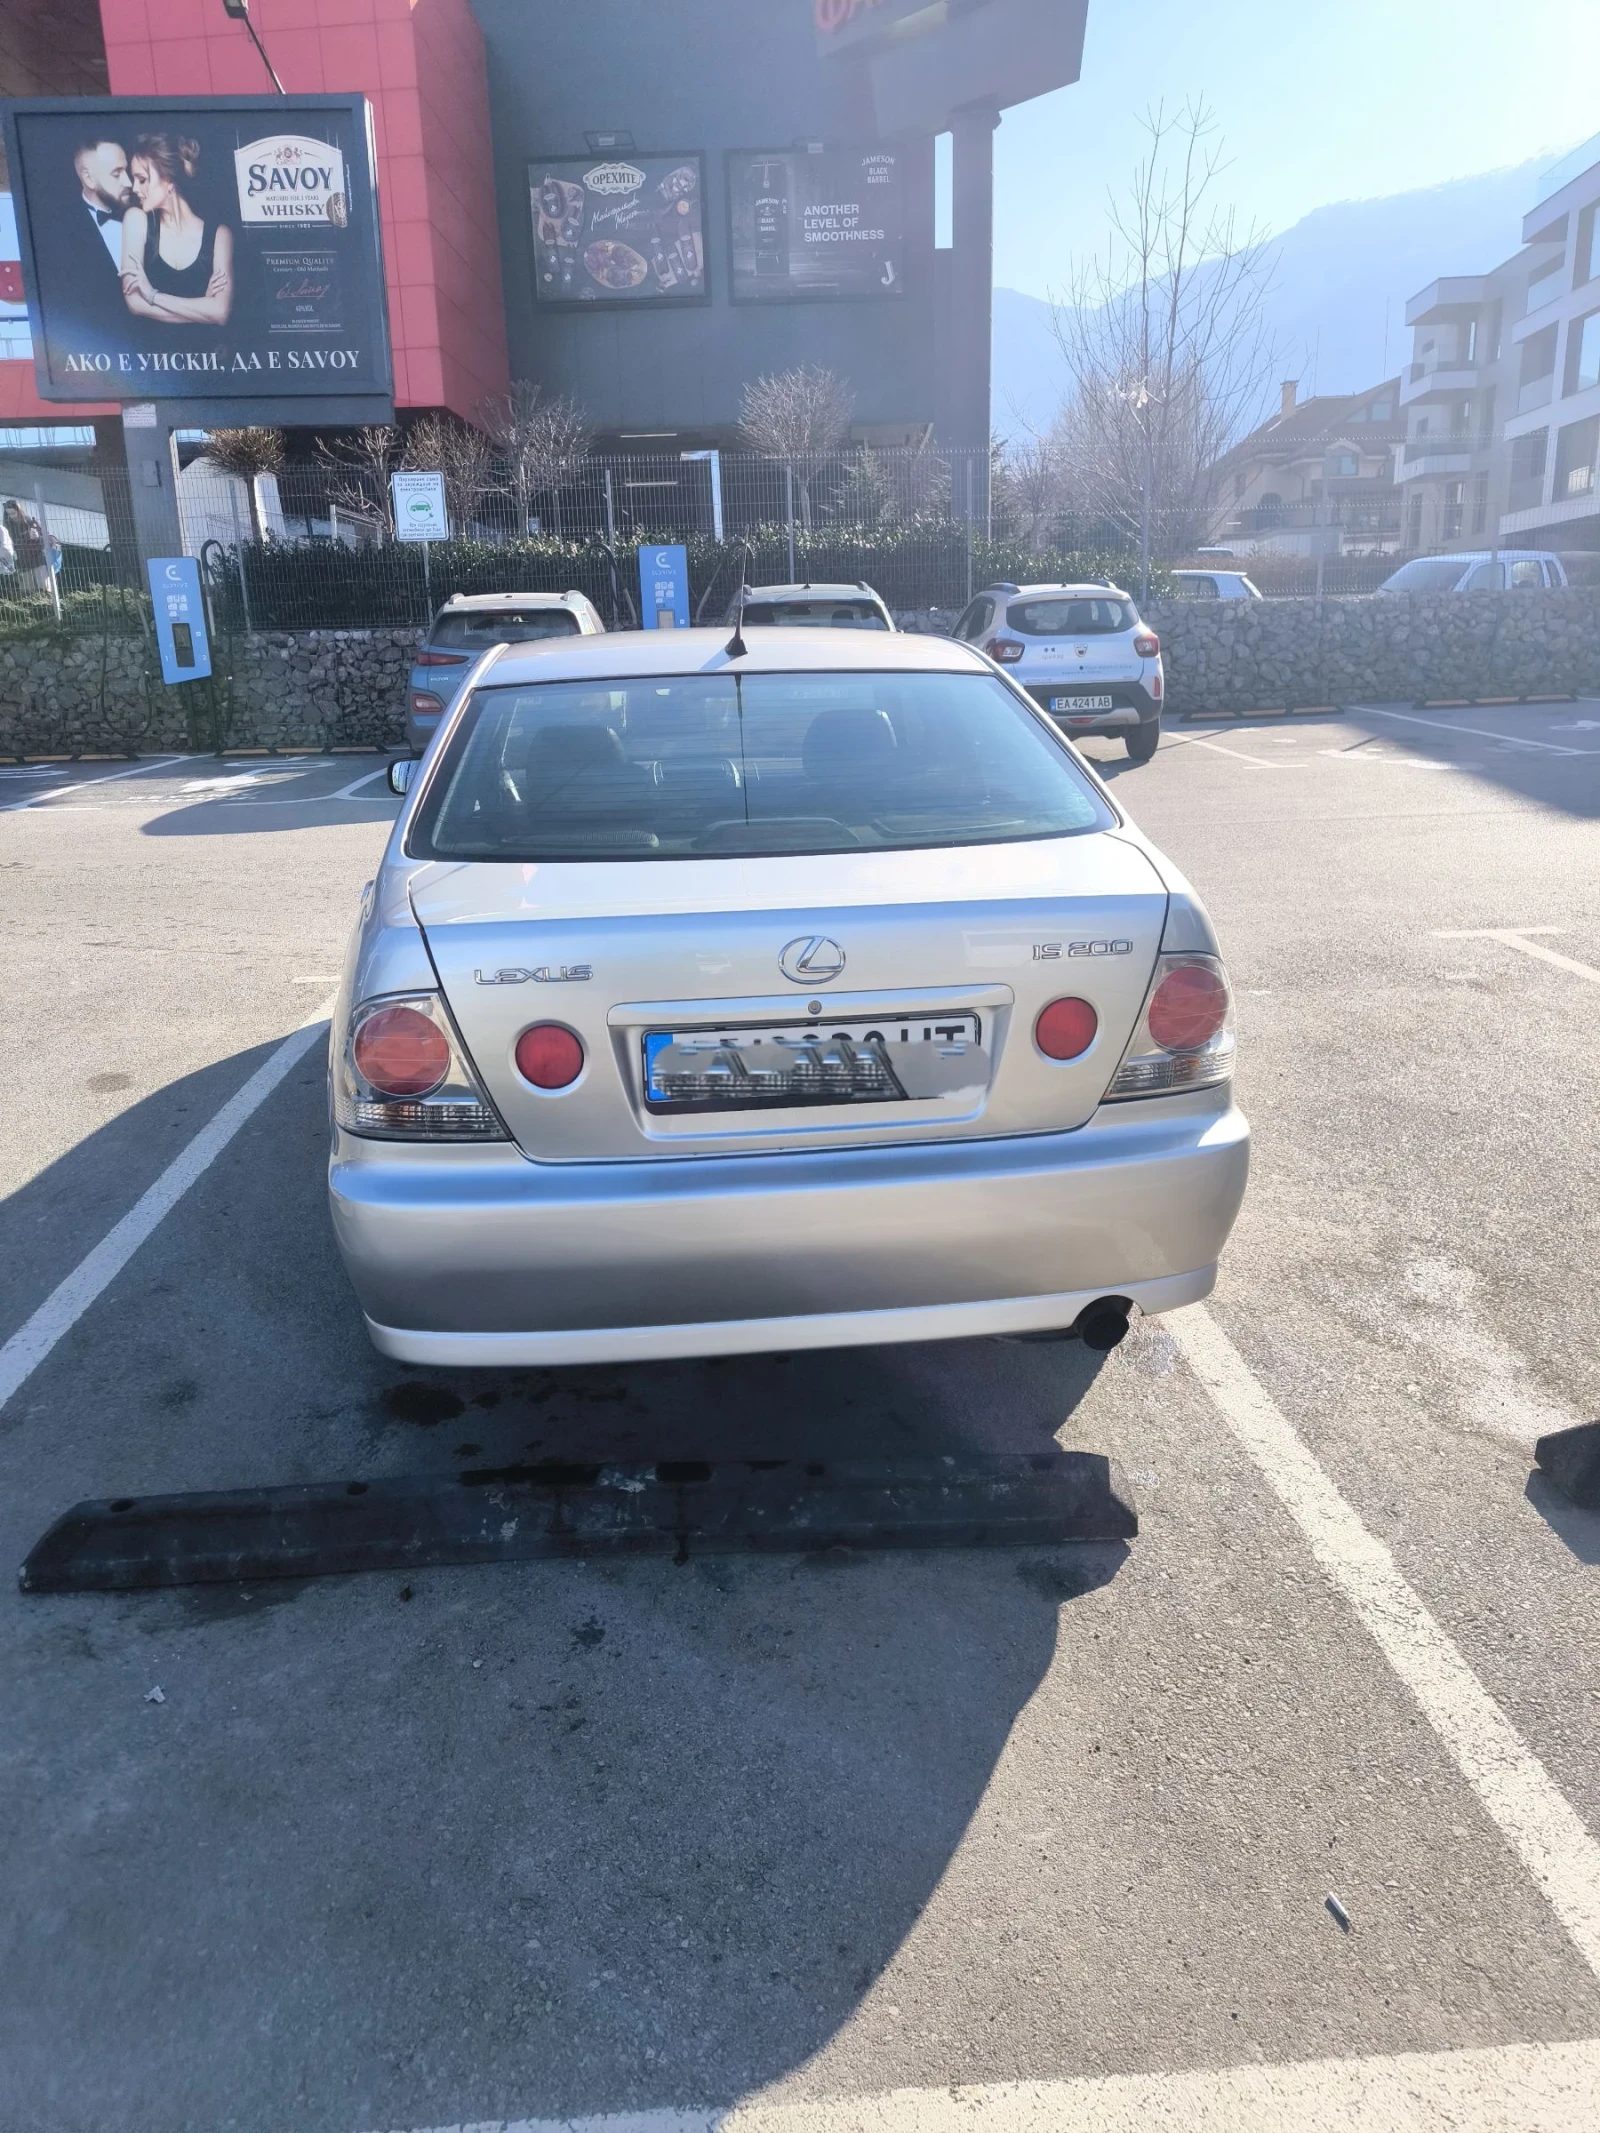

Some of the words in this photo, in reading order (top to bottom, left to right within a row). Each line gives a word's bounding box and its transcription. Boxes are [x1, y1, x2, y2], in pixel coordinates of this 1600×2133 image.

[861, 155, 895, 166] JAMESON
[869, 167, 888, 175] BLACK
[248, 164, 333, 197] SAVOY
[592, 172, 636, 185] ОРЕХИТЕ
[867, 175, 890, 184] BARREL
[261, 204, 325, 216] WHISKY
[804, 204, 860, 216] ANOTHER
[804, 218, 840, 229] LEVEL
[843, 217, 859, 228] OF
[804, 229, 885, 243] SMOOTHNESS
[302, 257, 334, 265] QUALITY
[65, 353, 111, 372] АКО
[119, 353, 132, 371] Е
[137, 352, 225, 373] УИСКИ,
[232, 351, 262, 374] ДА
[267, 351, 281, 369] Е
[288, 350, 360, 369] SAVOY
[1057, 698, 1071, 709] EA
[1072, 697, 1095, 708] 4241
[1097, 697, 1111, 707] AB
[1032, 943, 1063, 960] IS
[1068, 939, 1133, 957] 200
[474, 965, 593, 985] LEXUS
